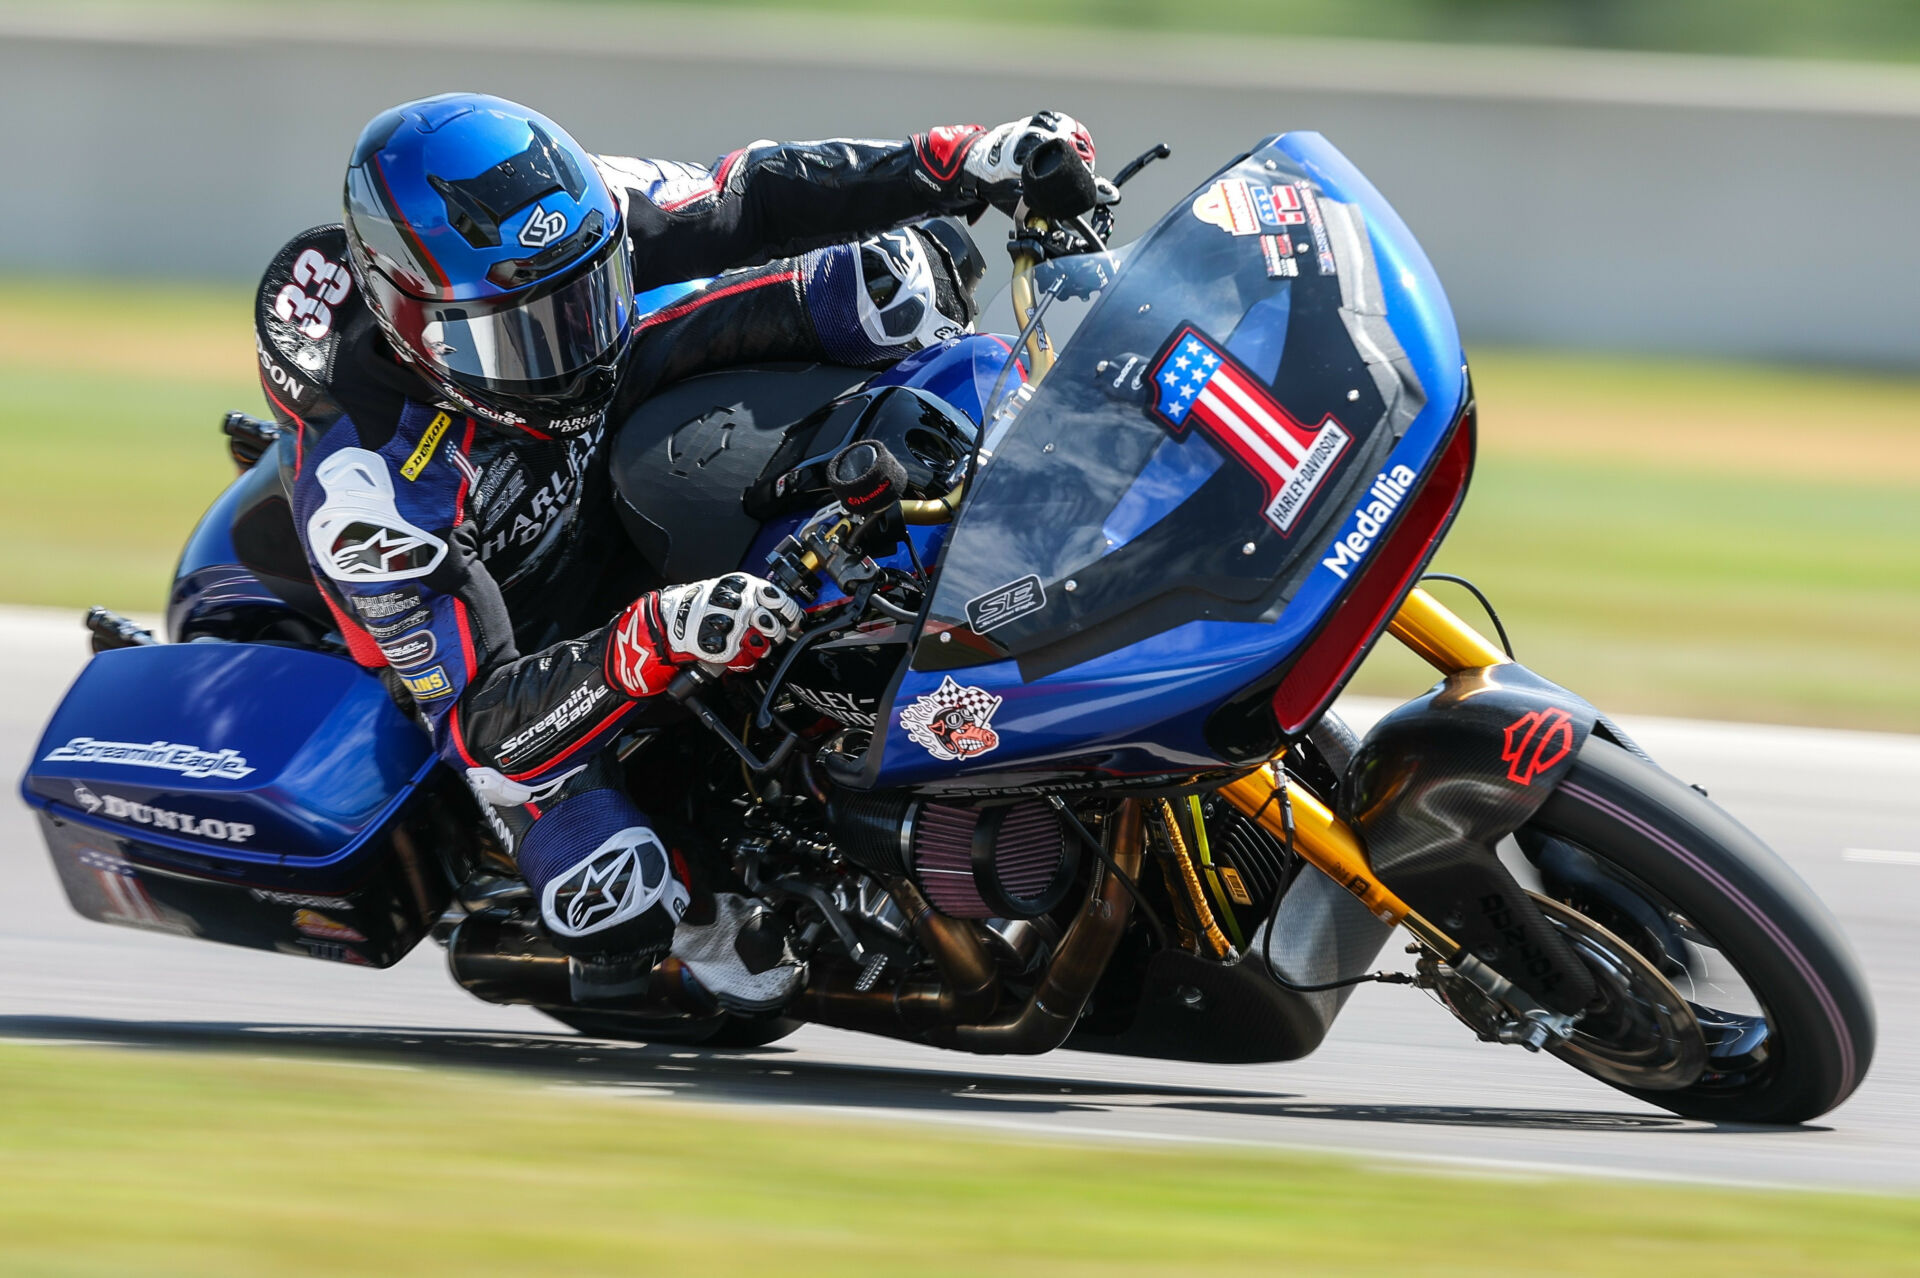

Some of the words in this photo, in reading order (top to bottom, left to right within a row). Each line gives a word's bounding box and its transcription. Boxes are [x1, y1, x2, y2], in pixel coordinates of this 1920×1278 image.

[275, 249, 352, 340] 33
[413, 416, 446, 467] DUNLOP
[1272, 428, 1342, 523] HARLEY-DAVIDSON
[1322, 463, 1415, 579] Medallia
[976, 581, 1034, 624] SE
[553, 684, 609, 732] Eagle
[101, 794, 256, 843] DUNLOP
